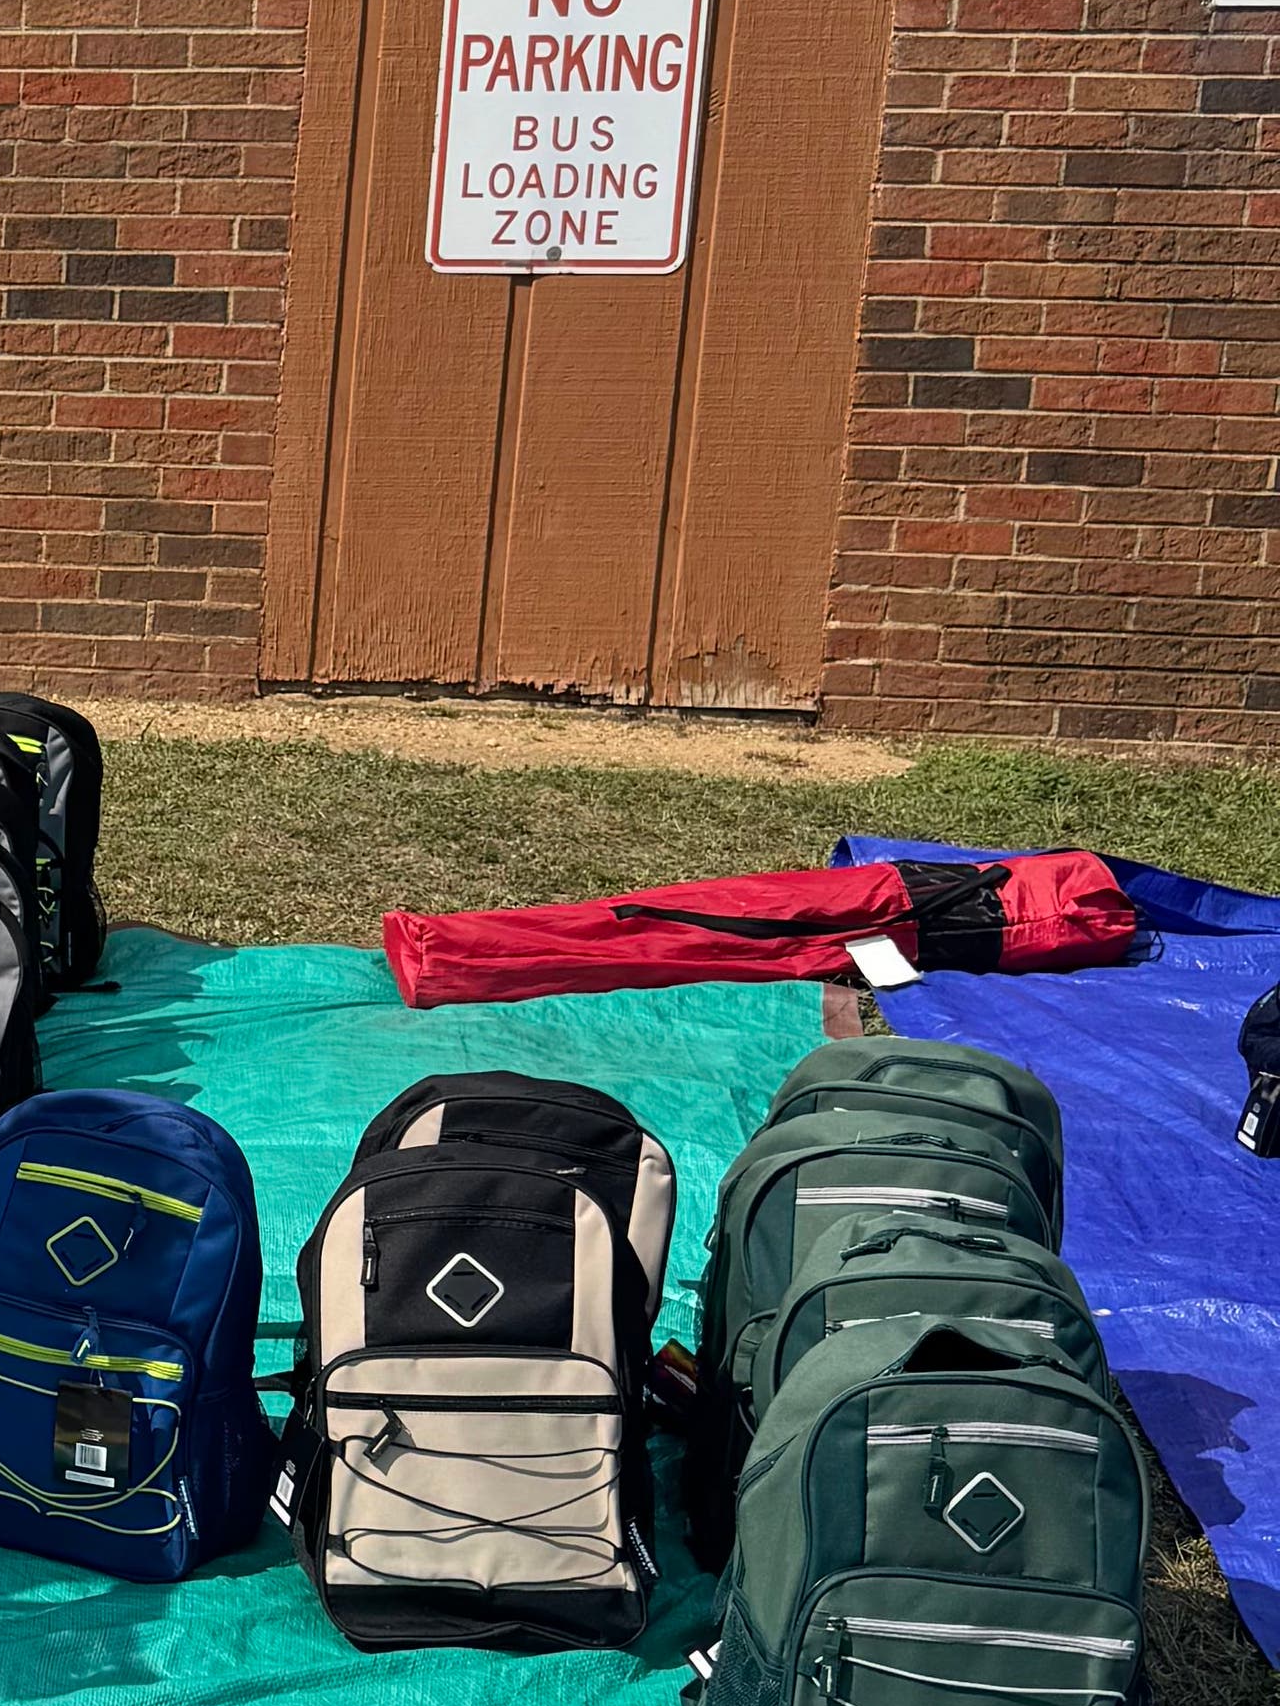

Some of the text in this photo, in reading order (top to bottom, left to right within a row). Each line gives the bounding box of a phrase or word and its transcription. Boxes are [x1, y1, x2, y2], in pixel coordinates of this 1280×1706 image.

[458, 33, 683, 93] PARKING
[512, 115, 615, 152] BUS
[461, 162, 658, 199] LOADING
[491, 210, 619, 246] ZONE
